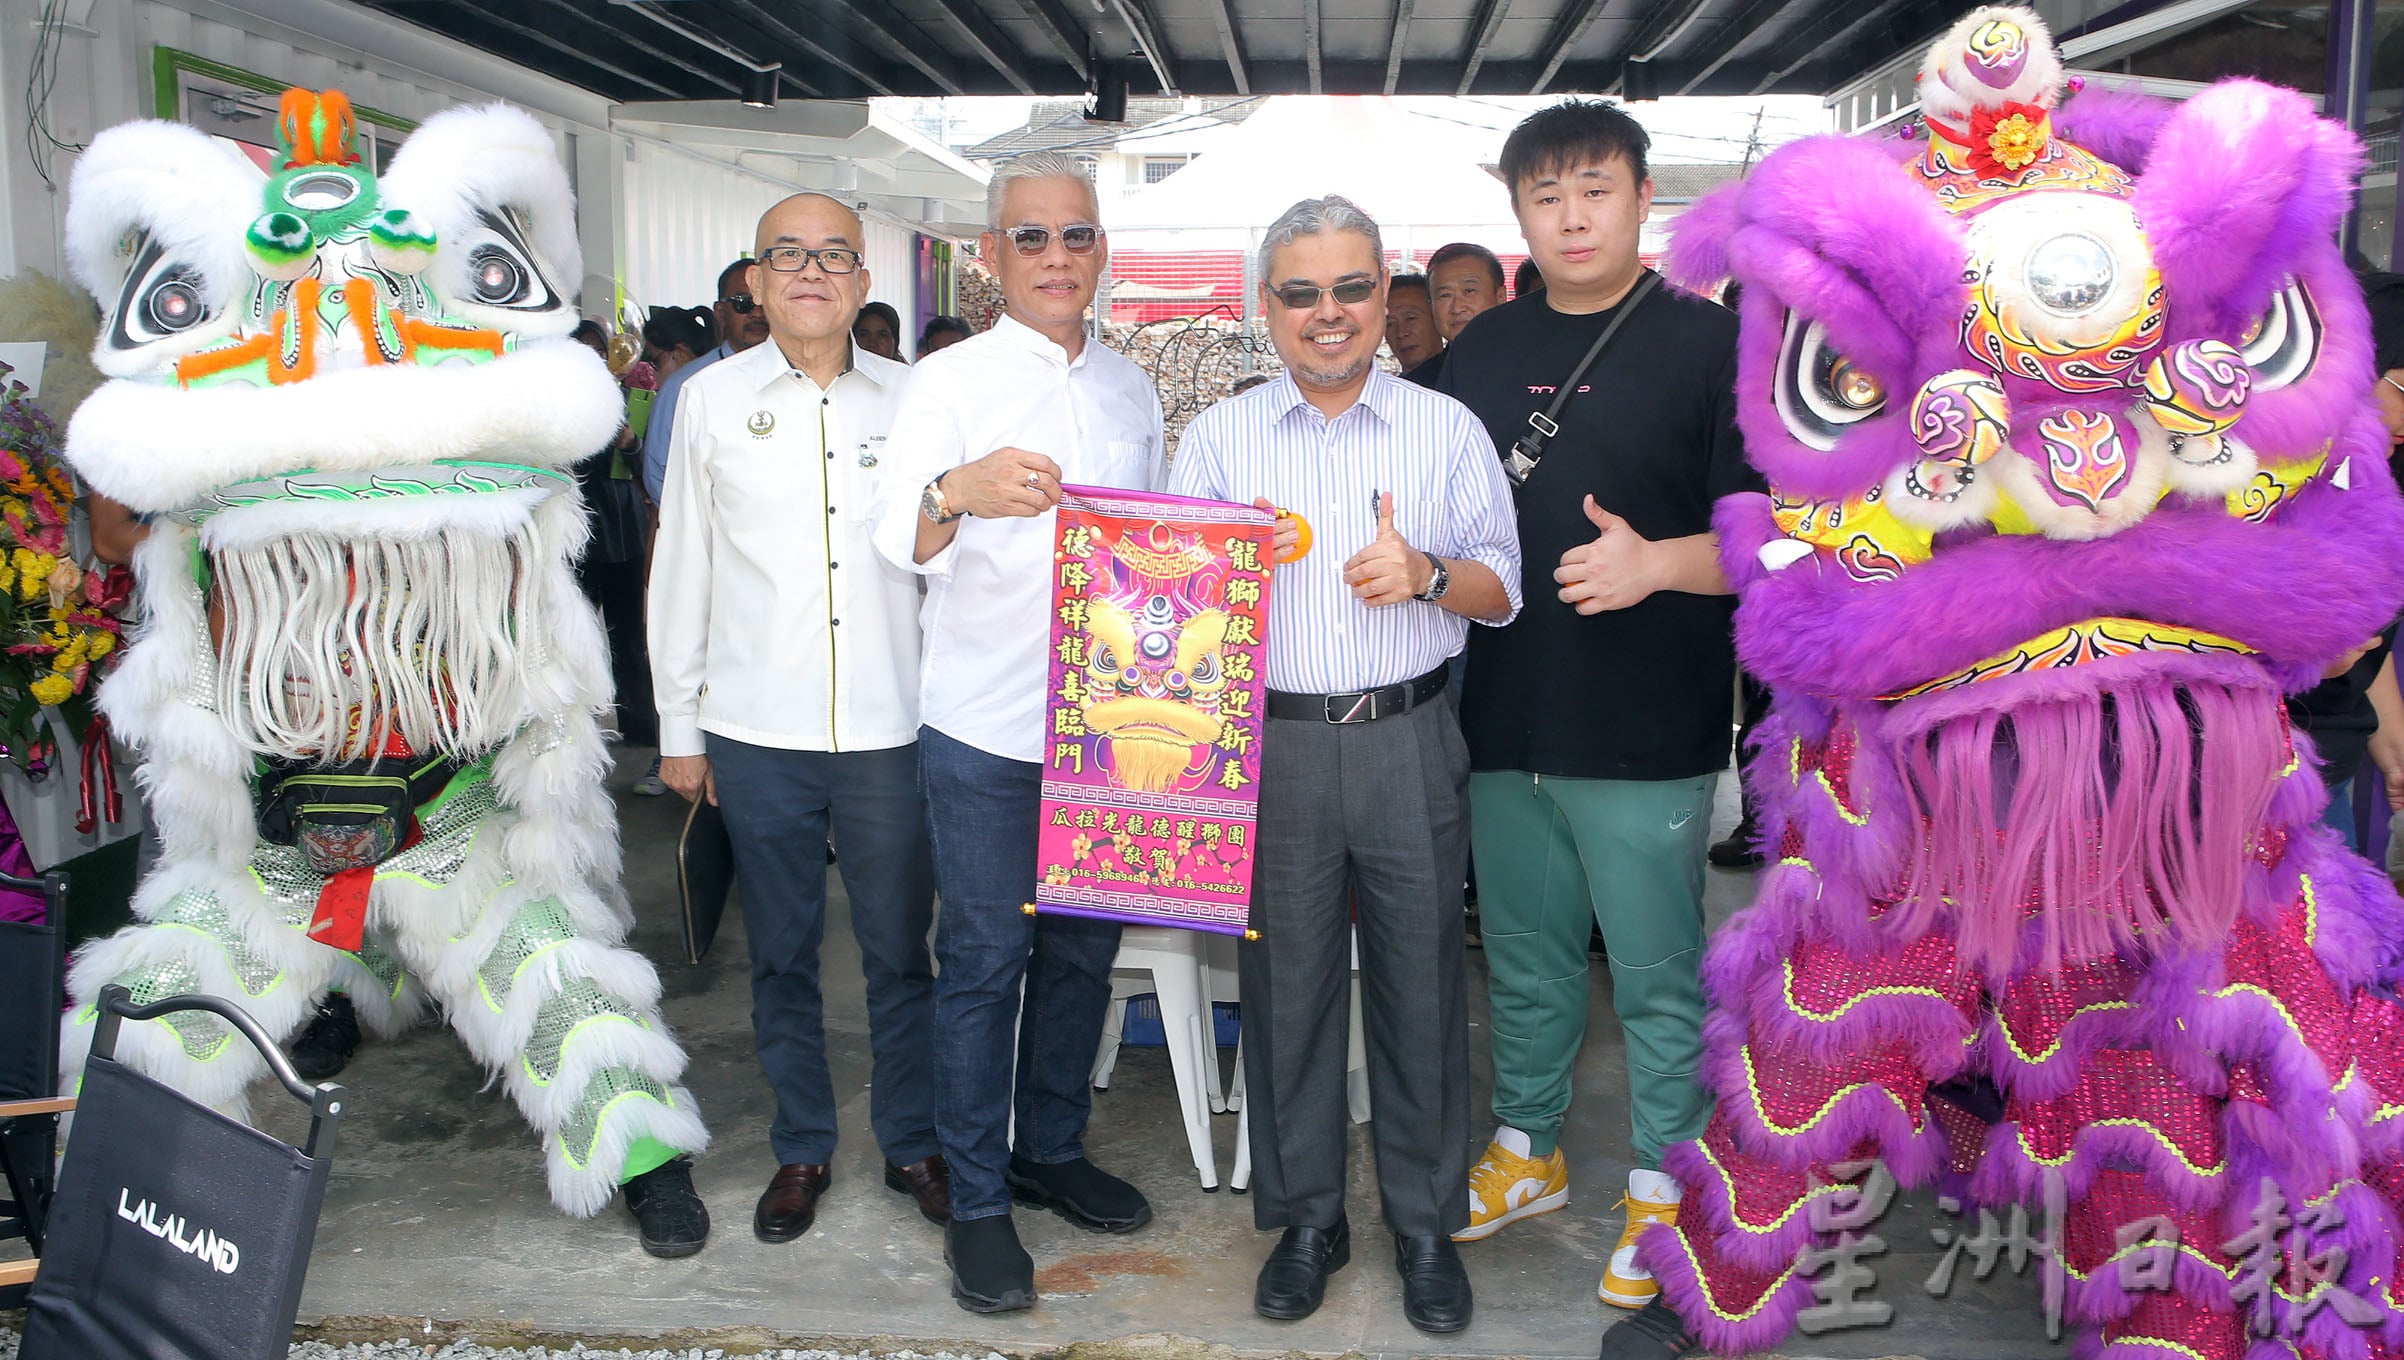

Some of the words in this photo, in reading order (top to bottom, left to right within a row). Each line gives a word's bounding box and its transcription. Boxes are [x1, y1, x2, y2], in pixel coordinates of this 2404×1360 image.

[1053, 526, 1095, 775] 德降祥龍喜臨門
[1218, 537, 1263, 792] 龍獅獻瑞迎新春
[1051, 807, 1245, 847] 瓜拉光龍德醒獅團
[1123, 845, 1170, 871] 敬賀
[117, 1187, 240, 1274] LALALAND
